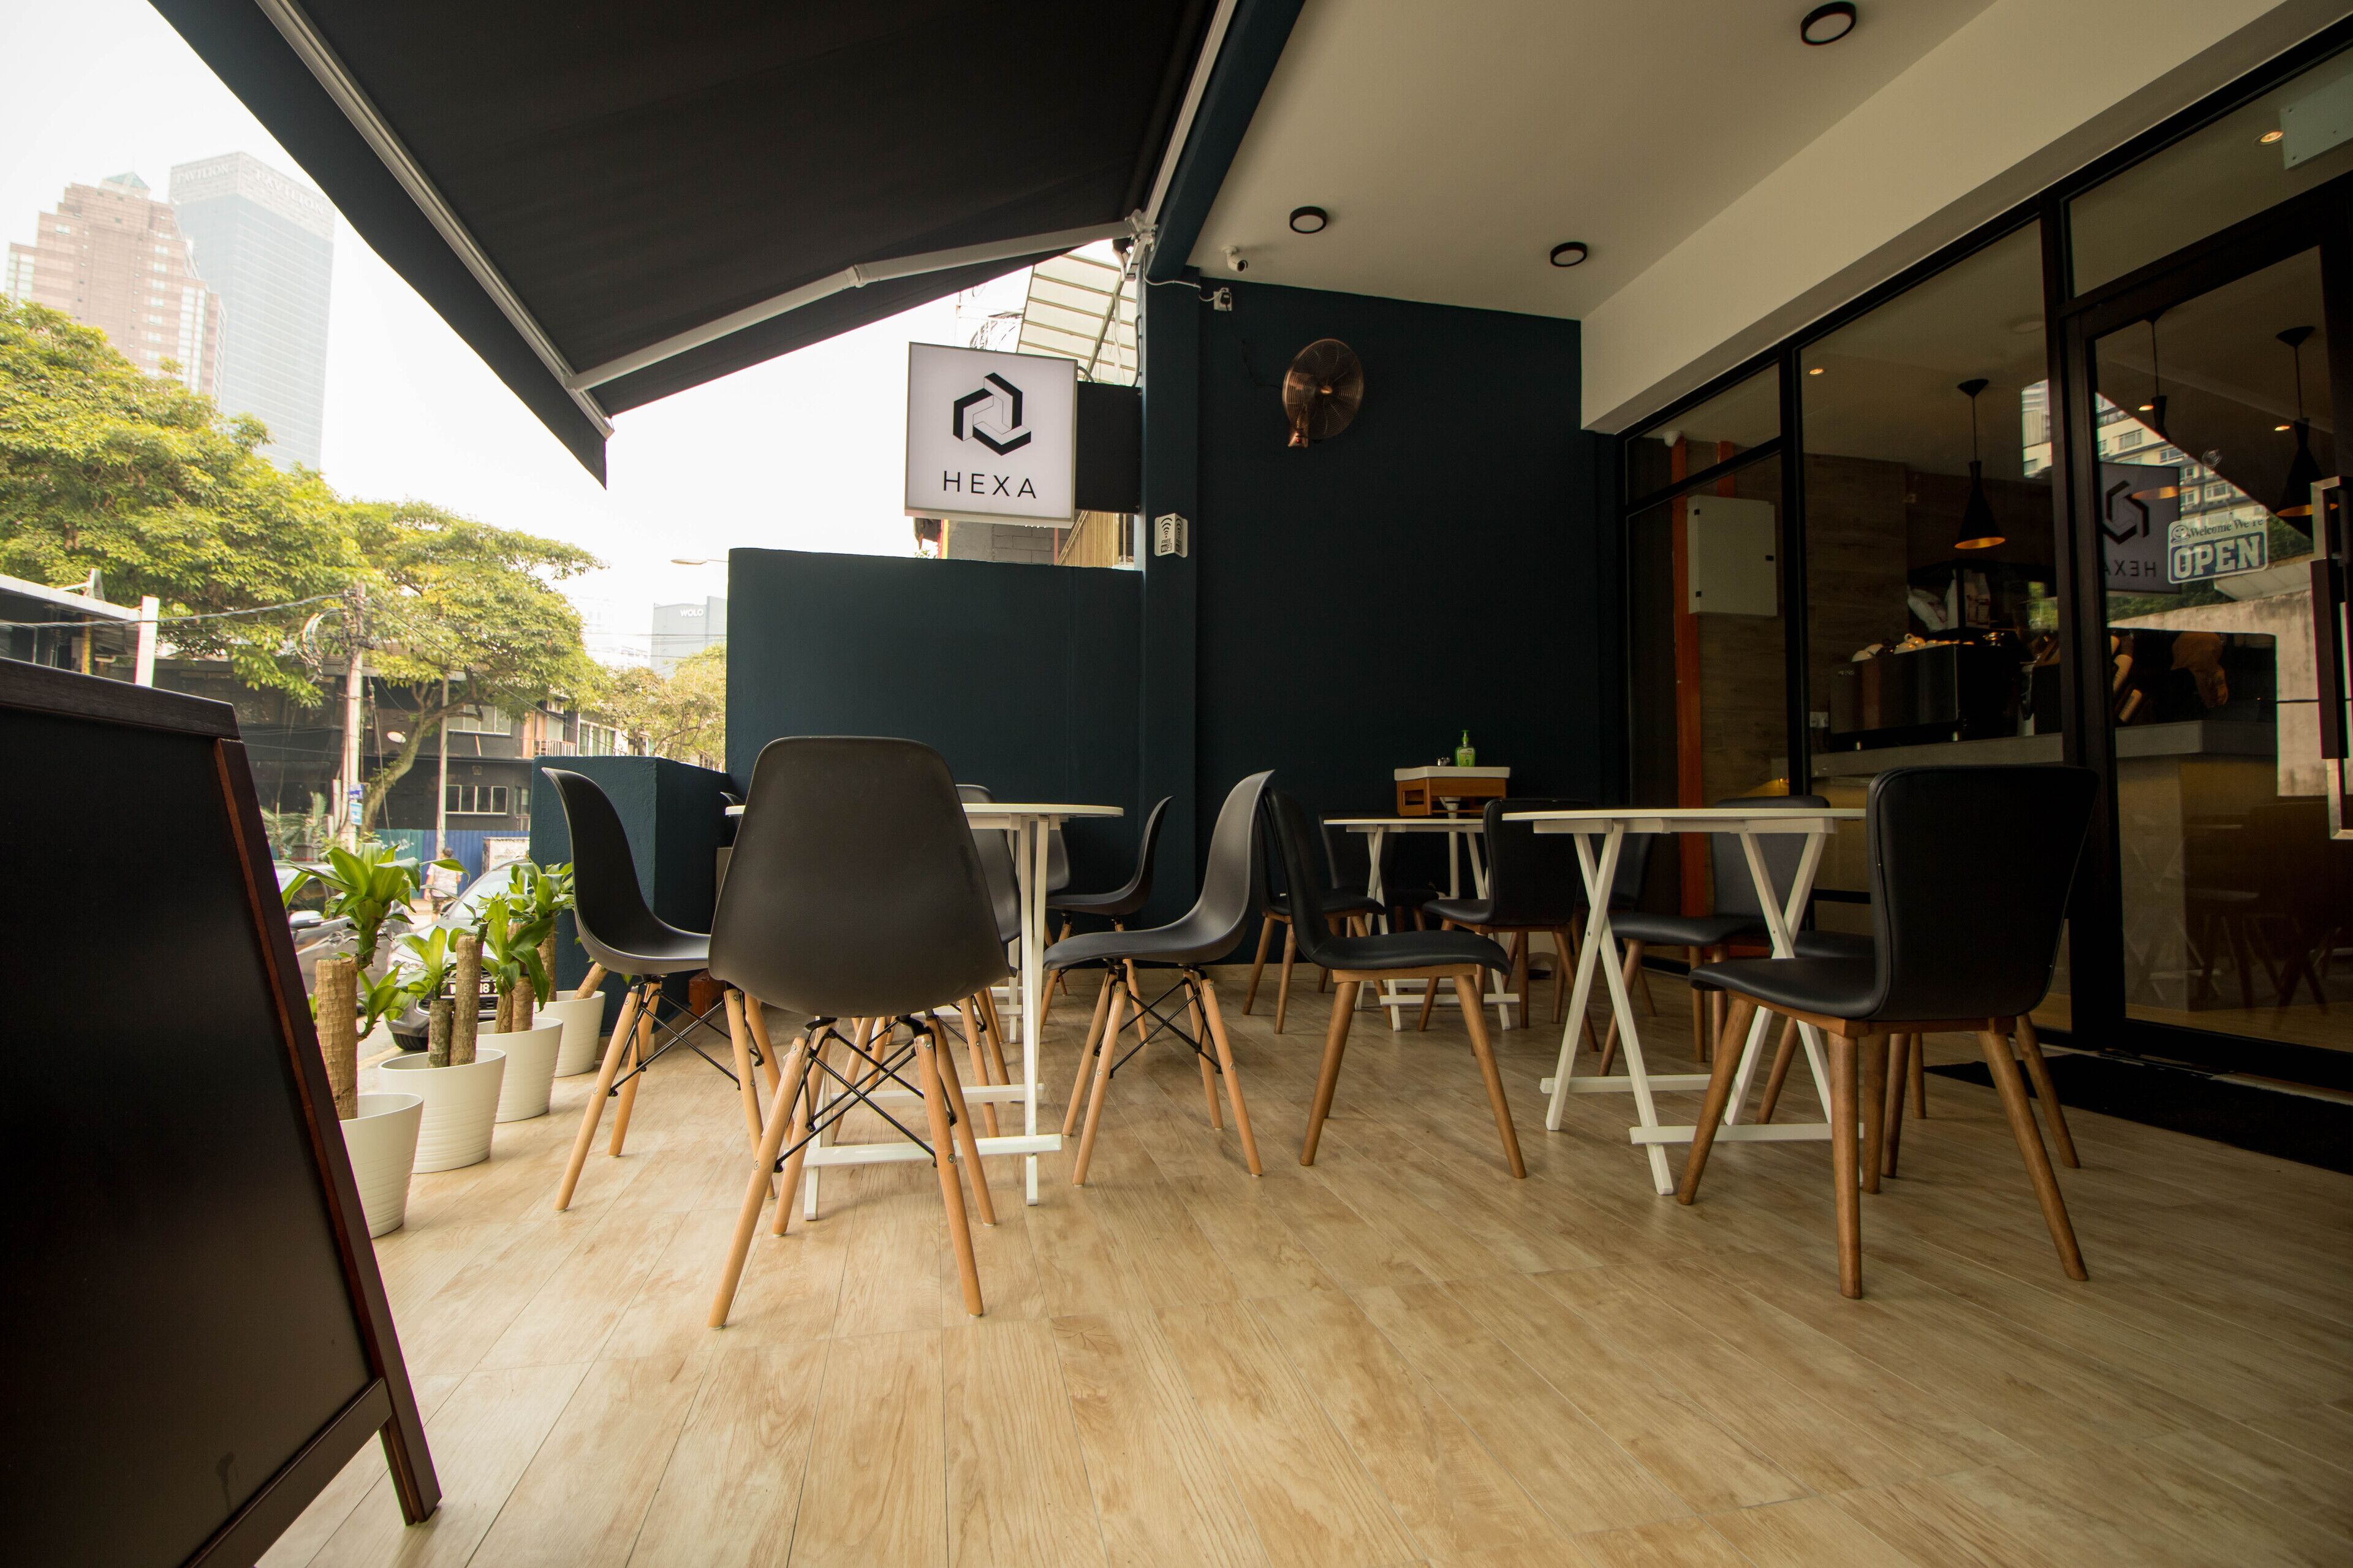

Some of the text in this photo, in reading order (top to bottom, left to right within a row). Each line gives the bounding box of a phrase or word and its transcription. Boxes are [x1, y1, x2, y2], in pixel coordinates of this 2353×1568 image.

[944, 470, 1037, 499] HEXA
[2189, 518, 2264, 538] Welcome Were
[2173, 536, 2260, 578] OPEN
[680, 608, 704, 617] WOLO
